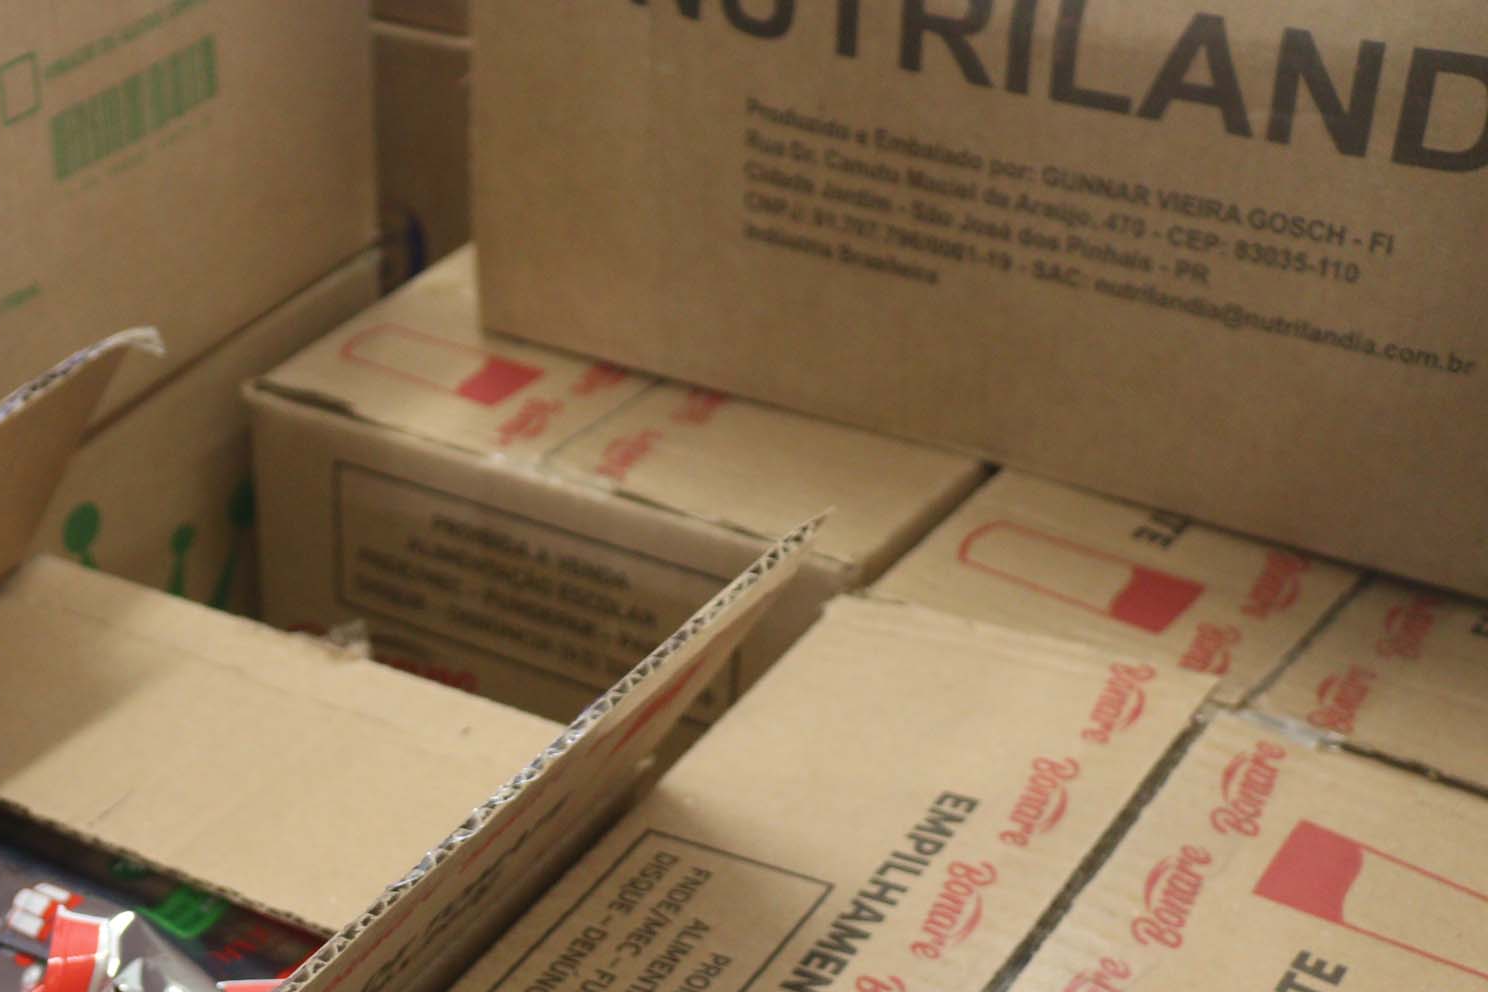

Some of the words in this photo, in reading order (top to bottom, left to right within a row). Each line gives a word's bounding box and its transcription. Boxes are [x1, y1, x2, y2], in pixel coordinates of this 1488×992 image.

[624, 0, 1488, 174] TRILAND
[1040, 164, 1152, 204] GUNNAR
[1157, 188, 1242, 226] VIEIRA
[1247, 206, 1348, 247] GOSCH
[1174, 259, 1210, 284] PR
[999, 756, 1080, 848] Bonare
[1211, 740, 1286, 838] Bonare
[613, 851, 680, 915] DISQUE
[615, 865, 714, 959] FNDE/MEC
[910, 860, 998, 960] Bonare
[1131, 844, 1212, 949] Bonare
